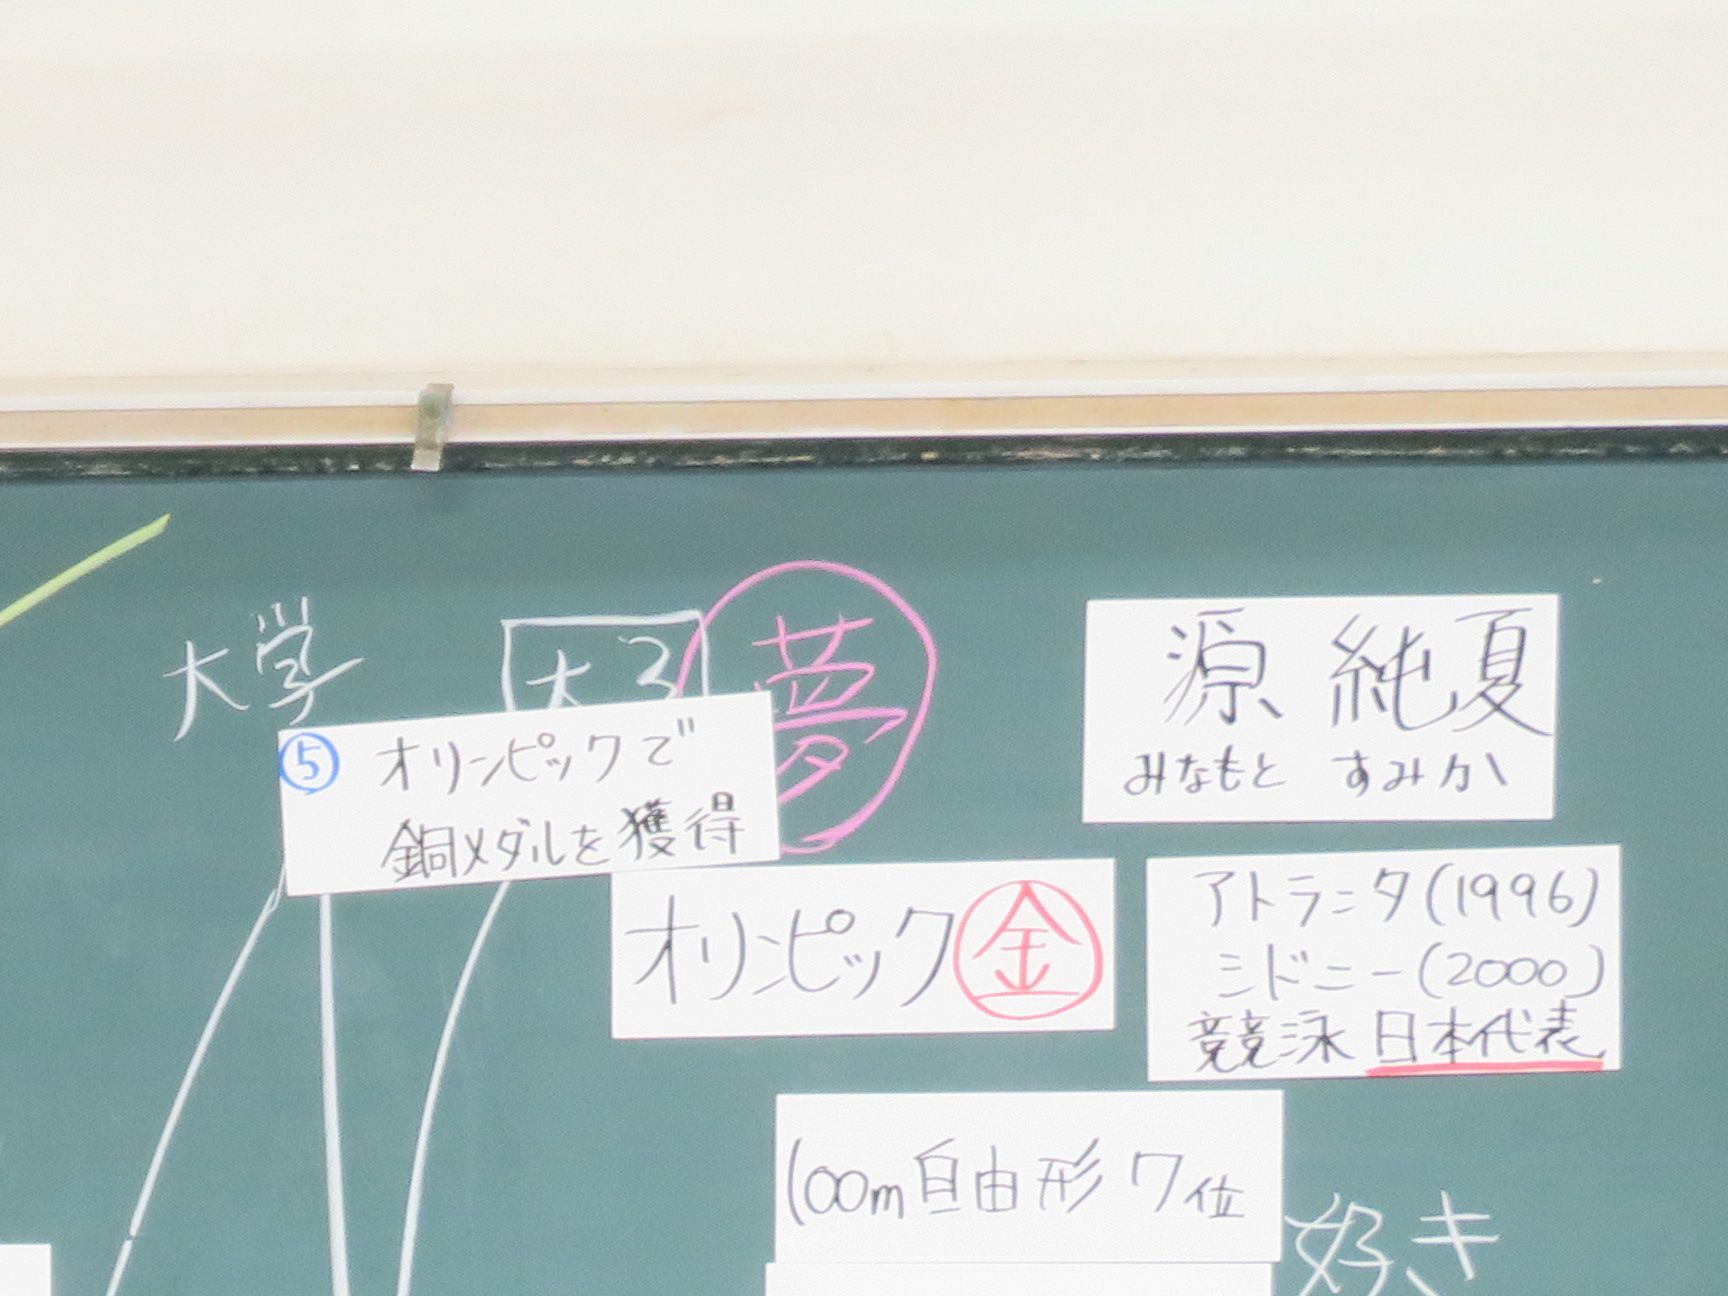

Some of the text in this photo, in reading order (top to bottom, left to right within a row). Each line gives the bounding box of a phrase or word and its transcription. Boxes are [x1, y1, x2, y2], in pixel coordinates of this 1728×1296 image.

[162, 596, 364, 742] 大学
[751, 614, 908, 807] 夢
[1162, 607, 1553, 738] 源 純夏
[375, 717, 695, 796] オリンピックで
[1122, 745, 1508, 798] みなもと すみか
[380, 791, 745, 883] 銅メダルを獲得
[624, 893, 956, 1008] オリンピック
